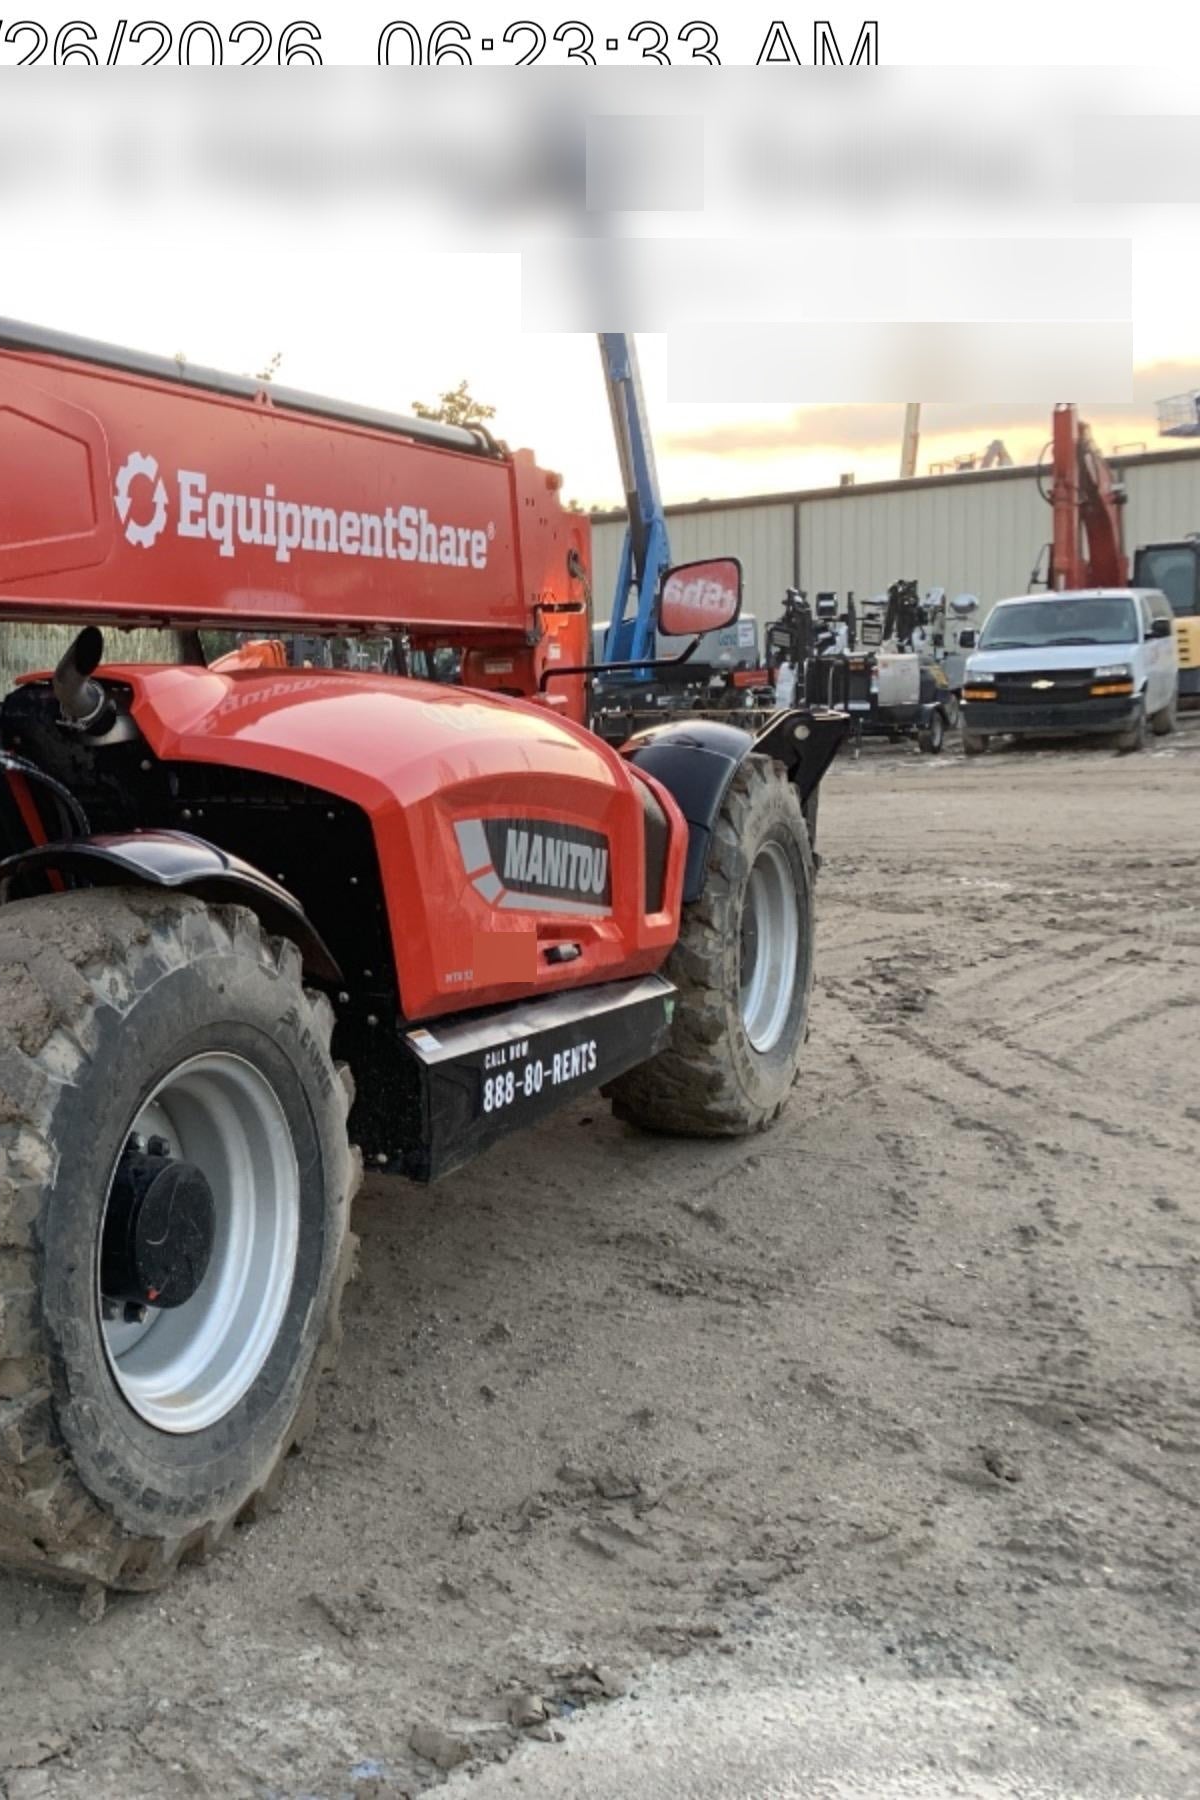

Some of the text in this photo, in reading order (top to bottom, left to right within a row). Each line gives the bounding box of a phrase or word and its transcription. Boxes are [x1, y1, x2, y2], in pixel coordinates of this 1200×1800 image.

[176, 469, 488, 570] EquipmentShare
[503, 828, 609, 895] MANITOU
[482, 1039, 598, 1112] 888-80-RENTS
[484, 1040, 529, 1070] CALL NOW
